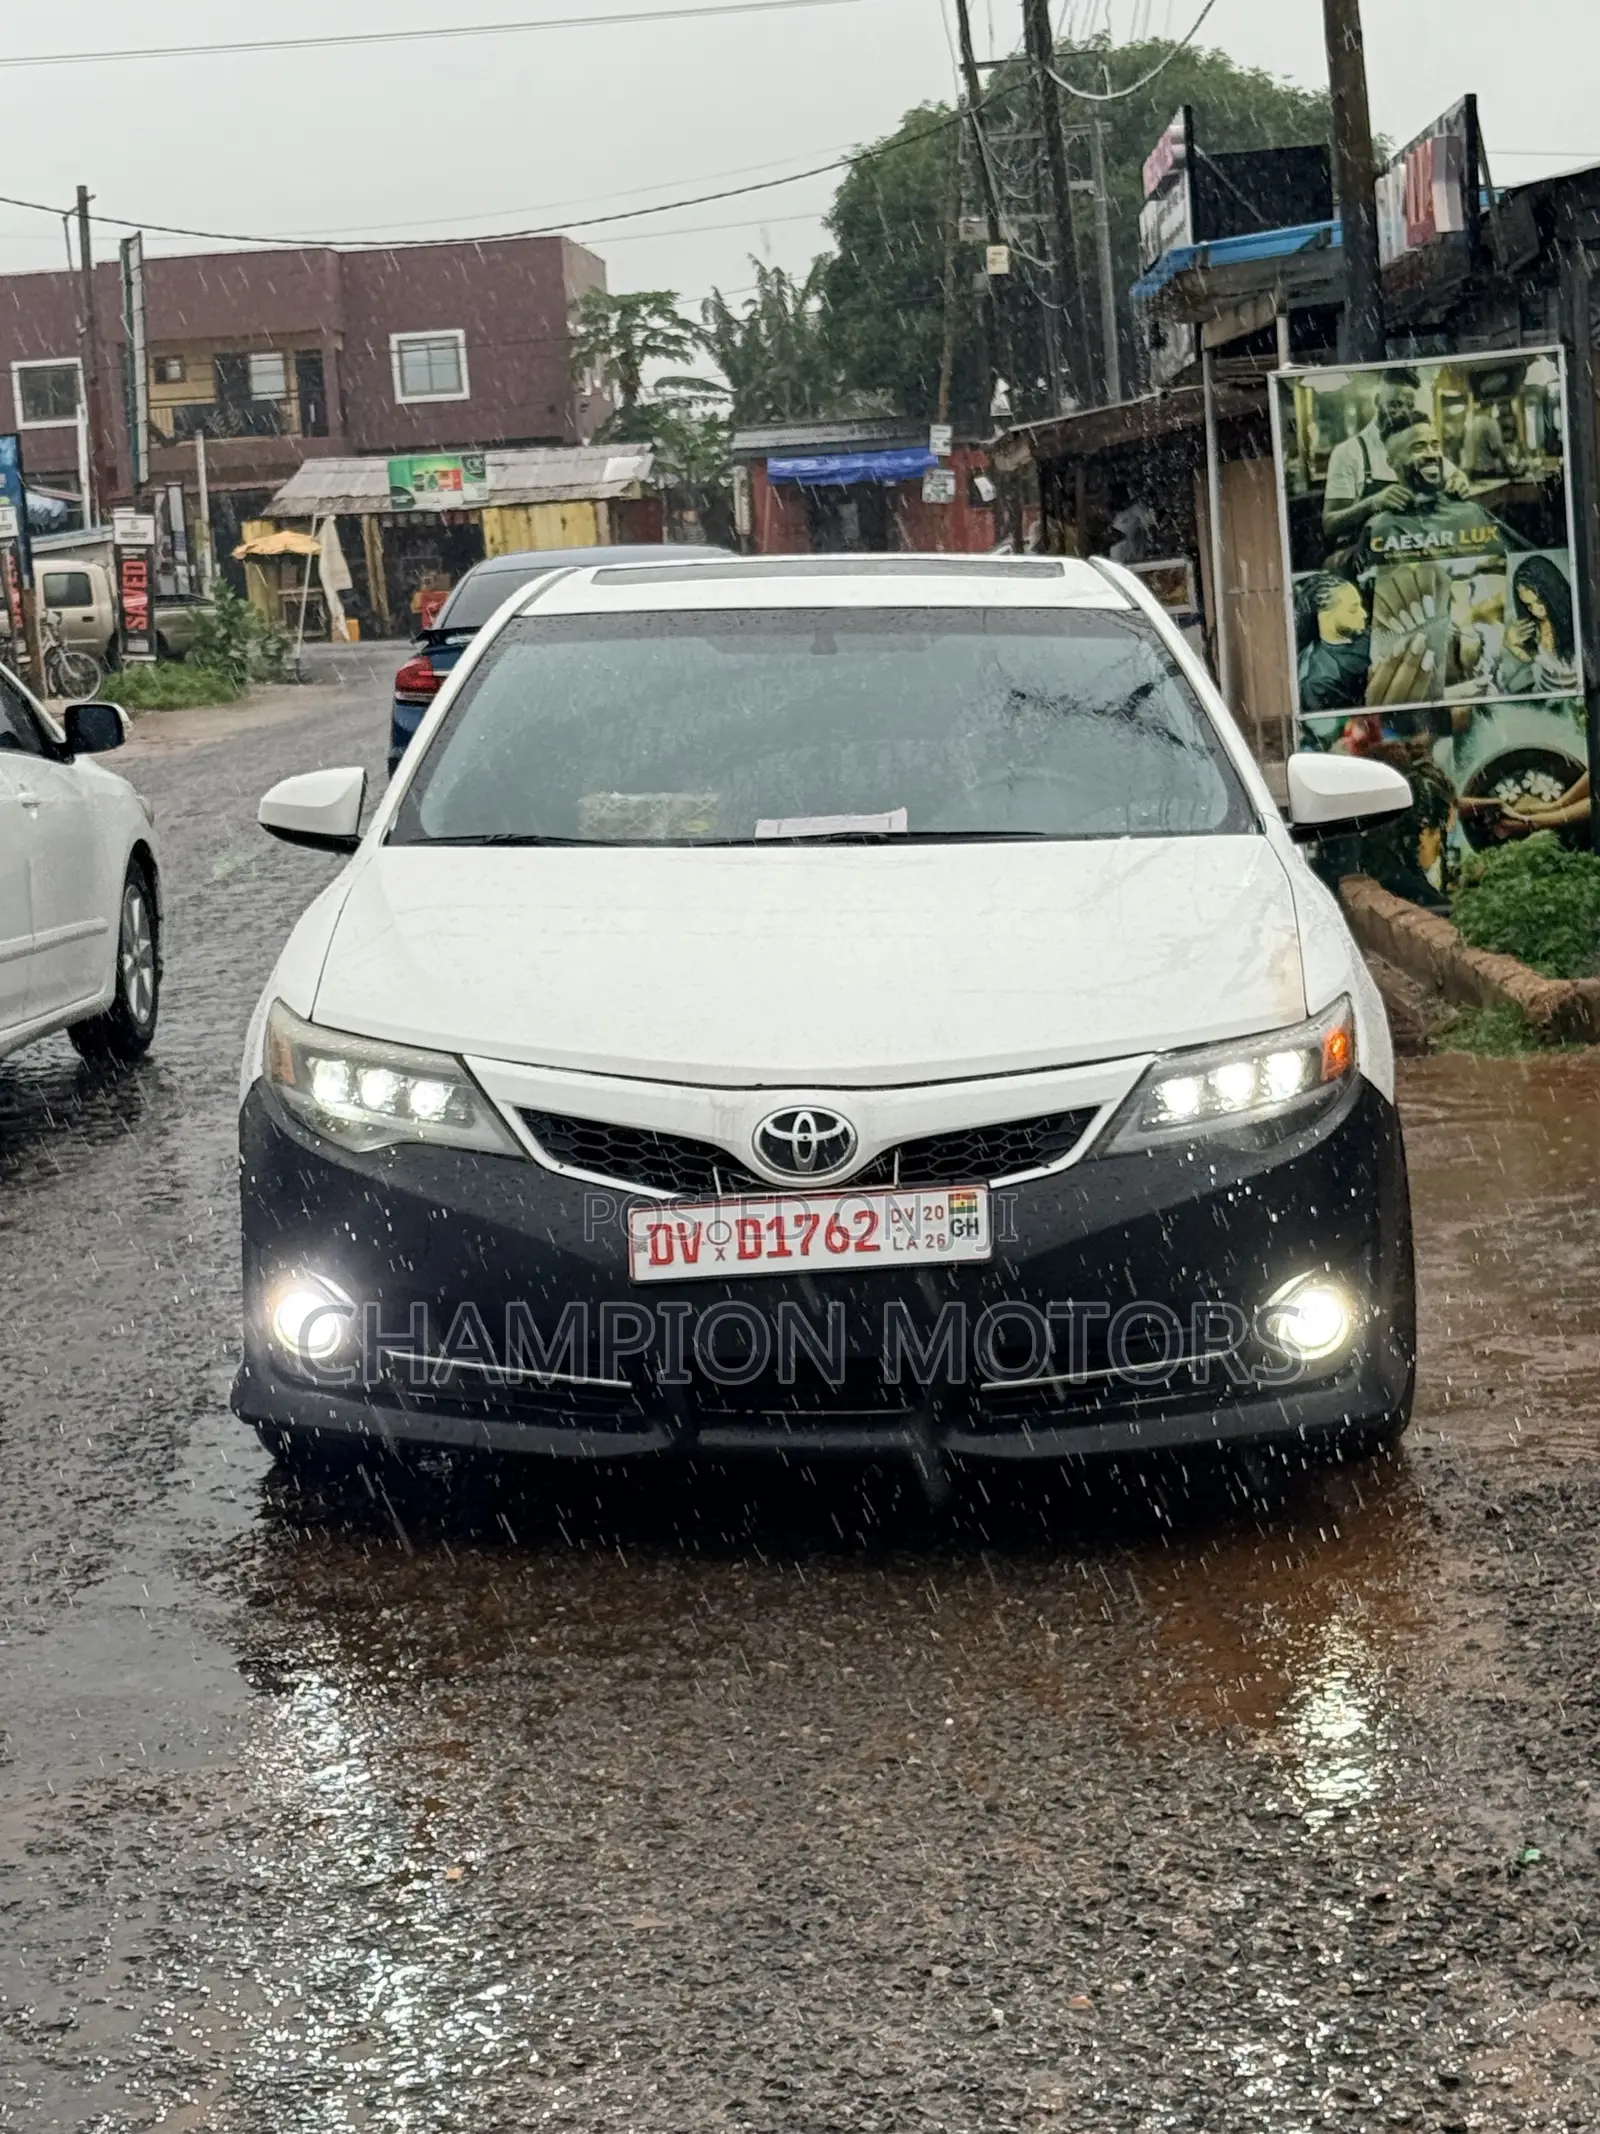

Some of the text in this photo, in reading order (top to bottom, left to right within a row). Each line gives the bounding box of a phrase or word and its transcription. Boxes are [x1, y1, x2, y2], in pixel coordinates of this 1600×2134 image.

[1370, 530, 1454, 552] CAESAR
[122, 560, 148, 630] SAVED
[923, 1204, 945, 1222] 20
[646, 1221, 702, 1266] DV
[735, 1210, 881, 1260] D1762
[950, 1216, 980, 1238] GH
[893, 1235, 919, 1251] LA
